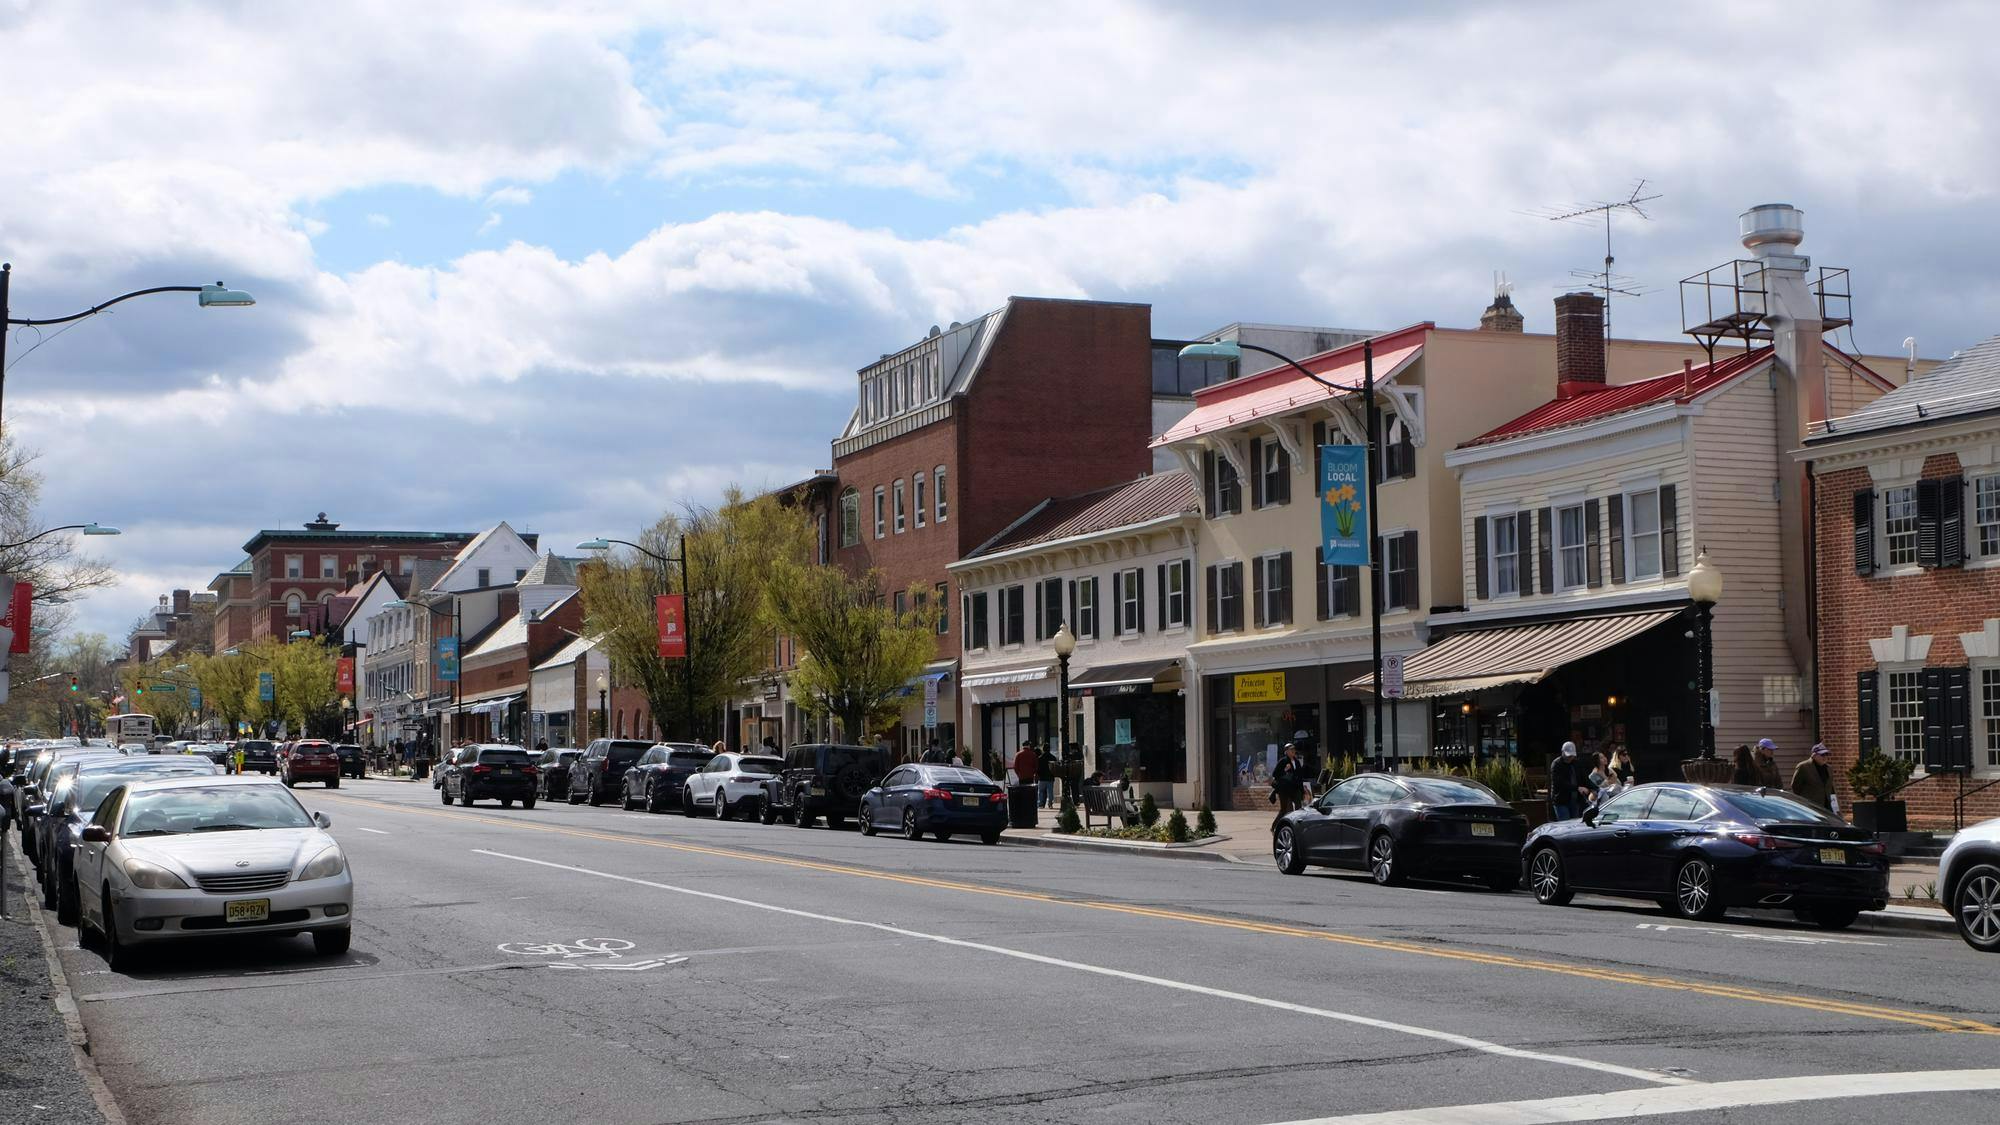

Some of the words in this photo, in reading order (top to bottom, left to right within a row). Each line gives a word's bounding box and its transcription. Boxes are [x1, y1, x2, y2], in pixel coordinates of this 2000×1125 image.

[1327, 463, 1358, 472] BLOOM
[1327, 472, 1357, 481] LOCAL
[1241, 678, 1265, 688] Princeton
